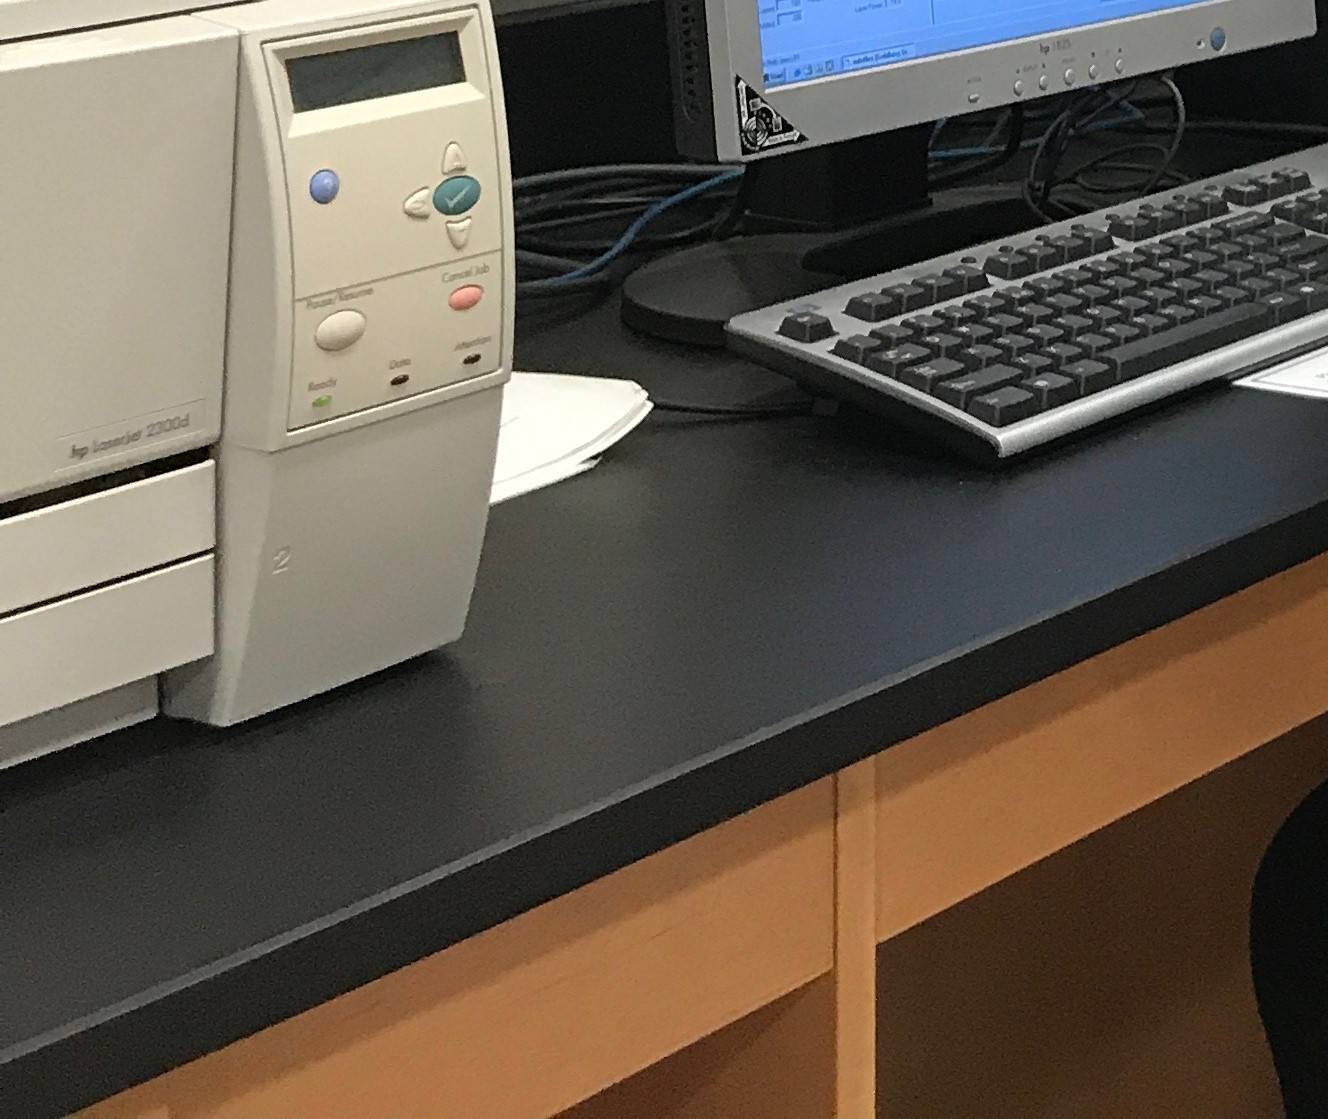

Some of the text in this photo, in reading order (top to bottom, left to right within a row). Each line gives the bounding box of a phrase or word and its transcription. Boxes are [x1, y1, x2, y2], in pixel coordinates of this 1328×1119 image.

[441, 268, 473, 283] Cancel
[389, 358, 411, 370] Data
[308, 378, 338, 392] Ready
[70, 445, 89, 459] hp
[146, 414, 190, 438] 2300d
